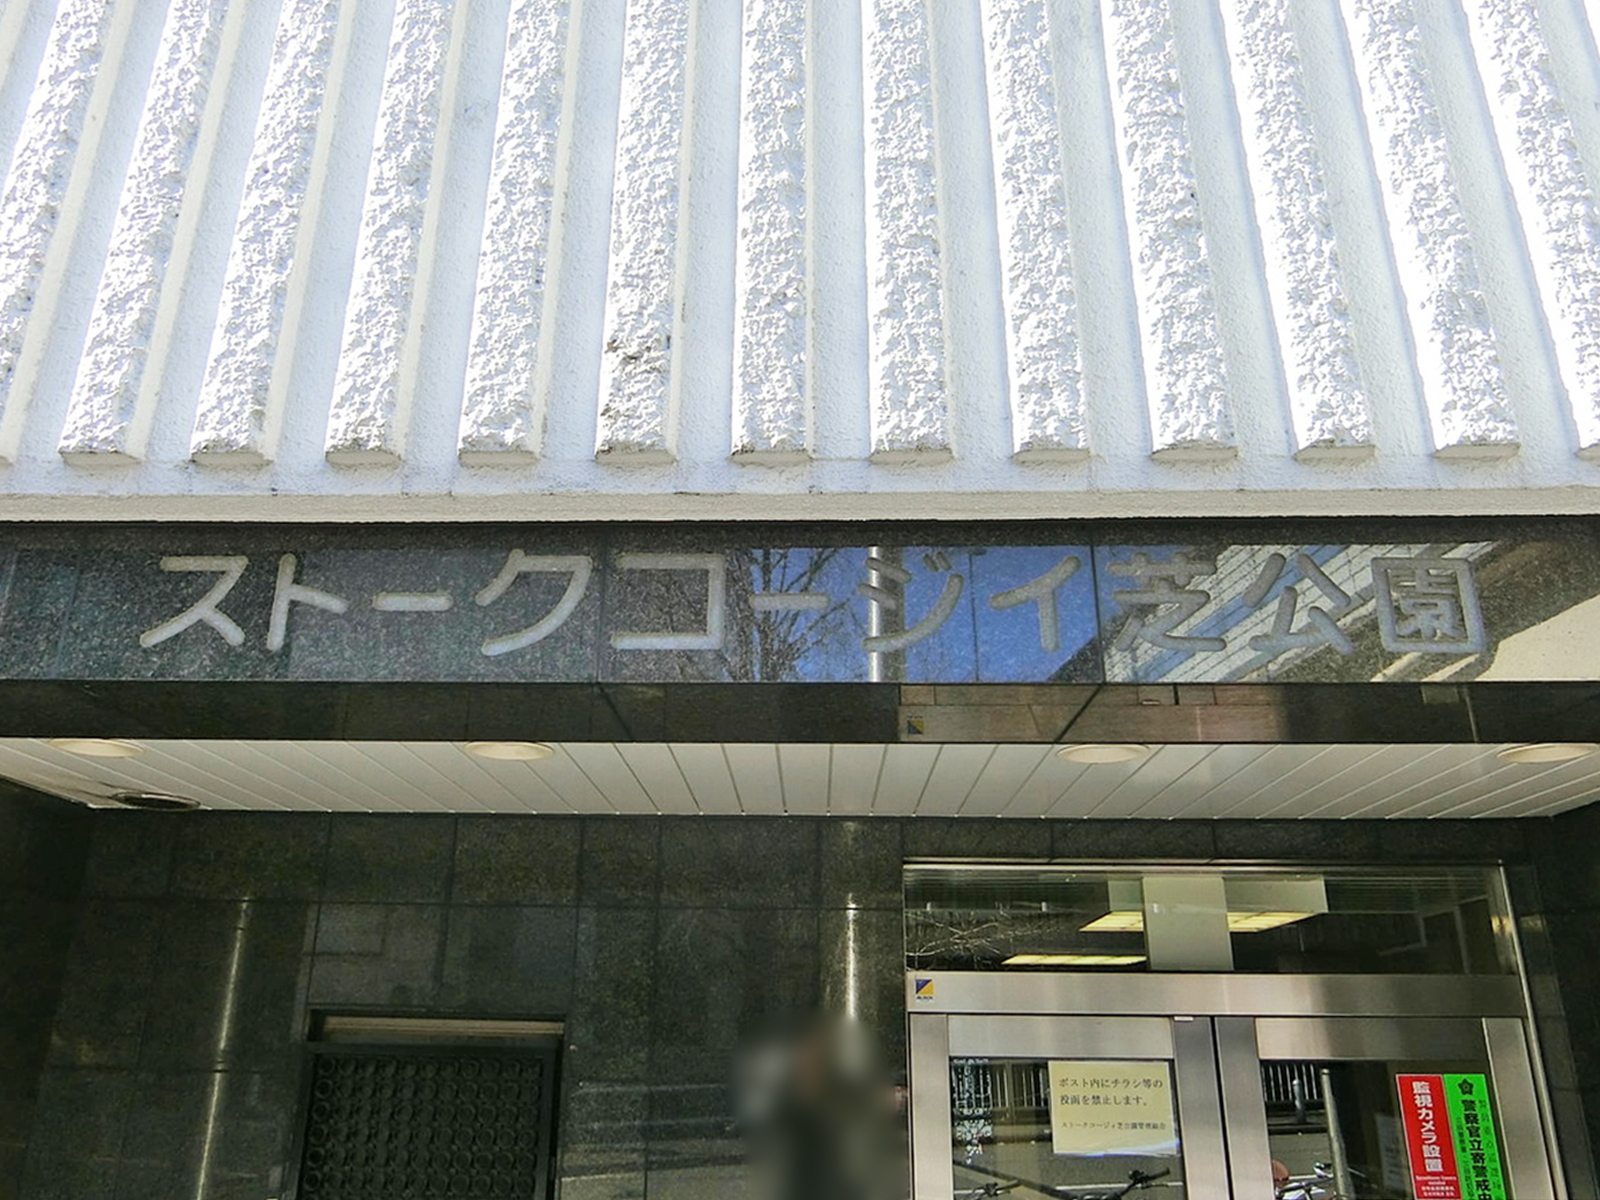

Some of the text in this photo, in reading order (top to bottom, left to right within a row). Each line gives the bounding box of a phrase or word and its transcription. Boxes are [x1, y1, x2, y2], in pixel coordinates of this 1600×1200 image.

[1059, 1077, 1163, 1089] ポスト内にチラシ等の
[1412, 1081, 1444, 1172] 監視カメラ設置
